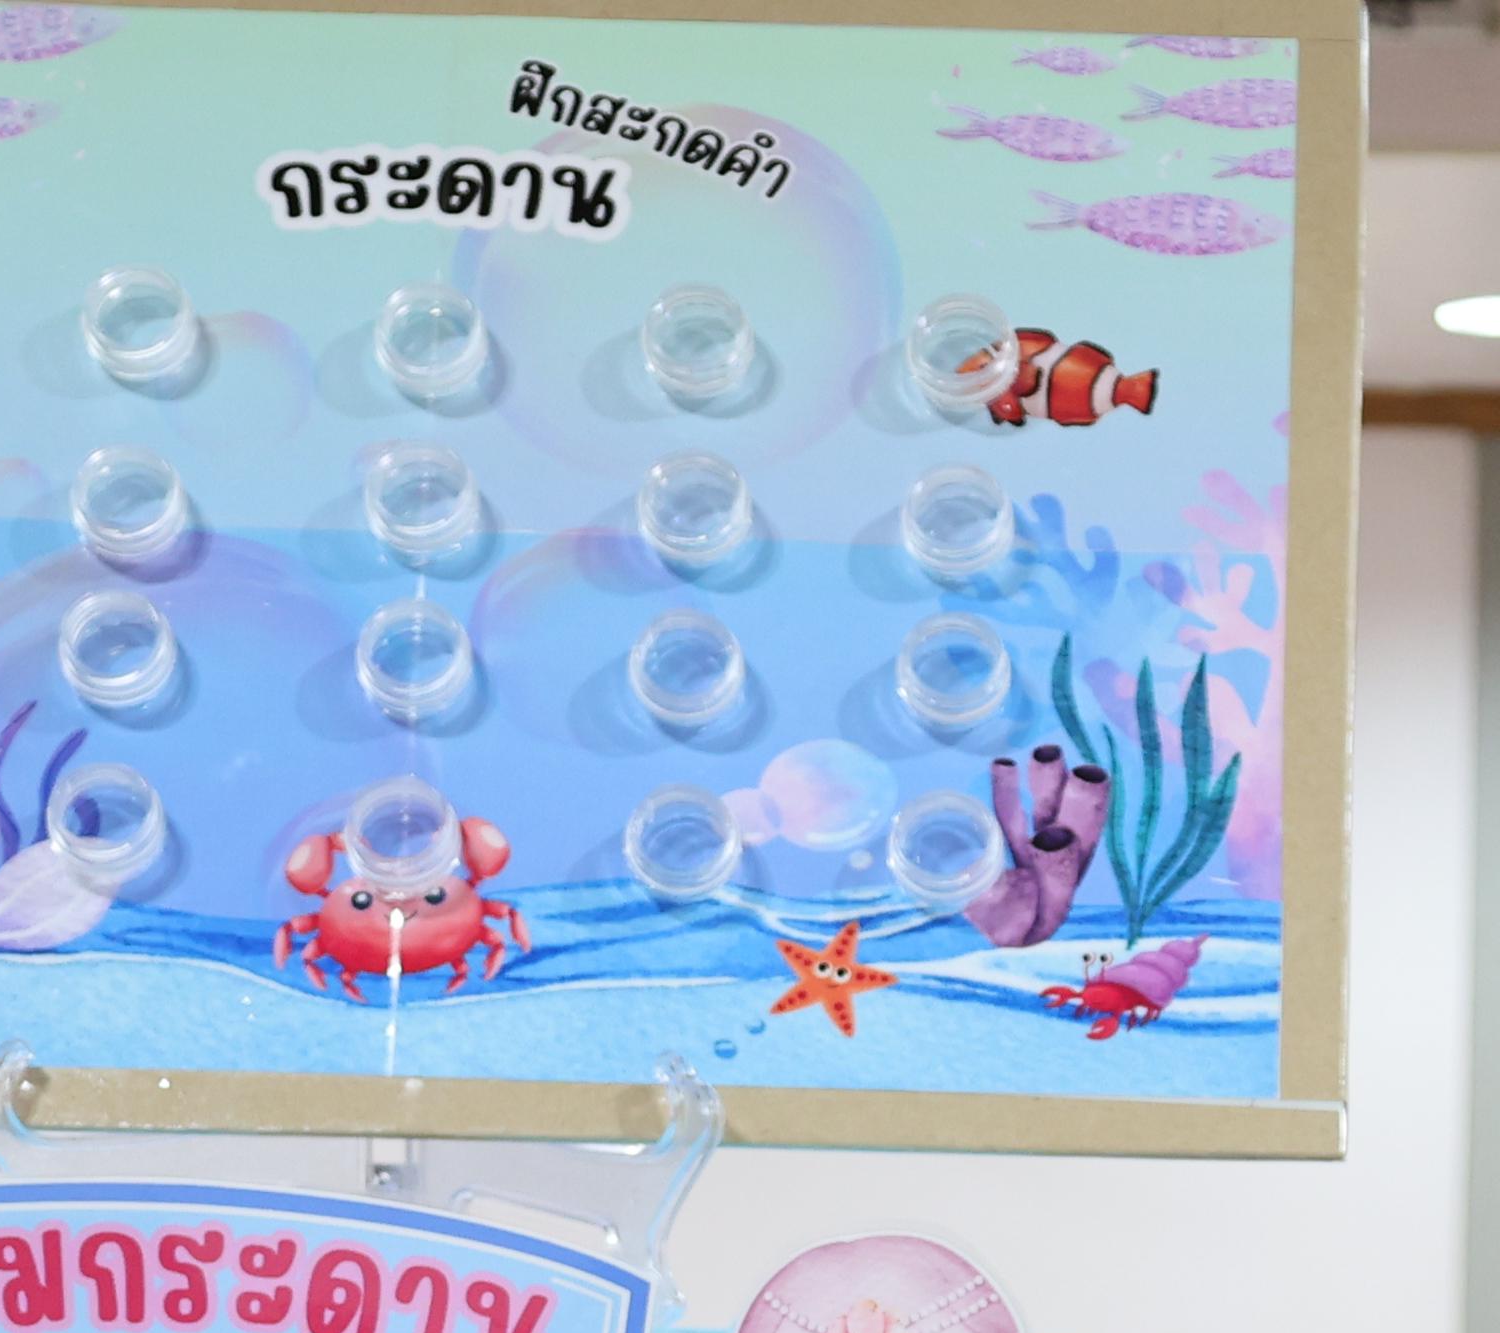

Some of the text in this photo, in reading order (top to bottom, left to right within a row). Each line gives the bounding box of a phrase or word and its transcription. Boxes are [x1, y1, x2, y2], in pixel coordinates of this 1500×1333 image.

[508, 60, 793, 200] ฝึกสะกดคำ
[271, 156, 617, 229] กระดาน
